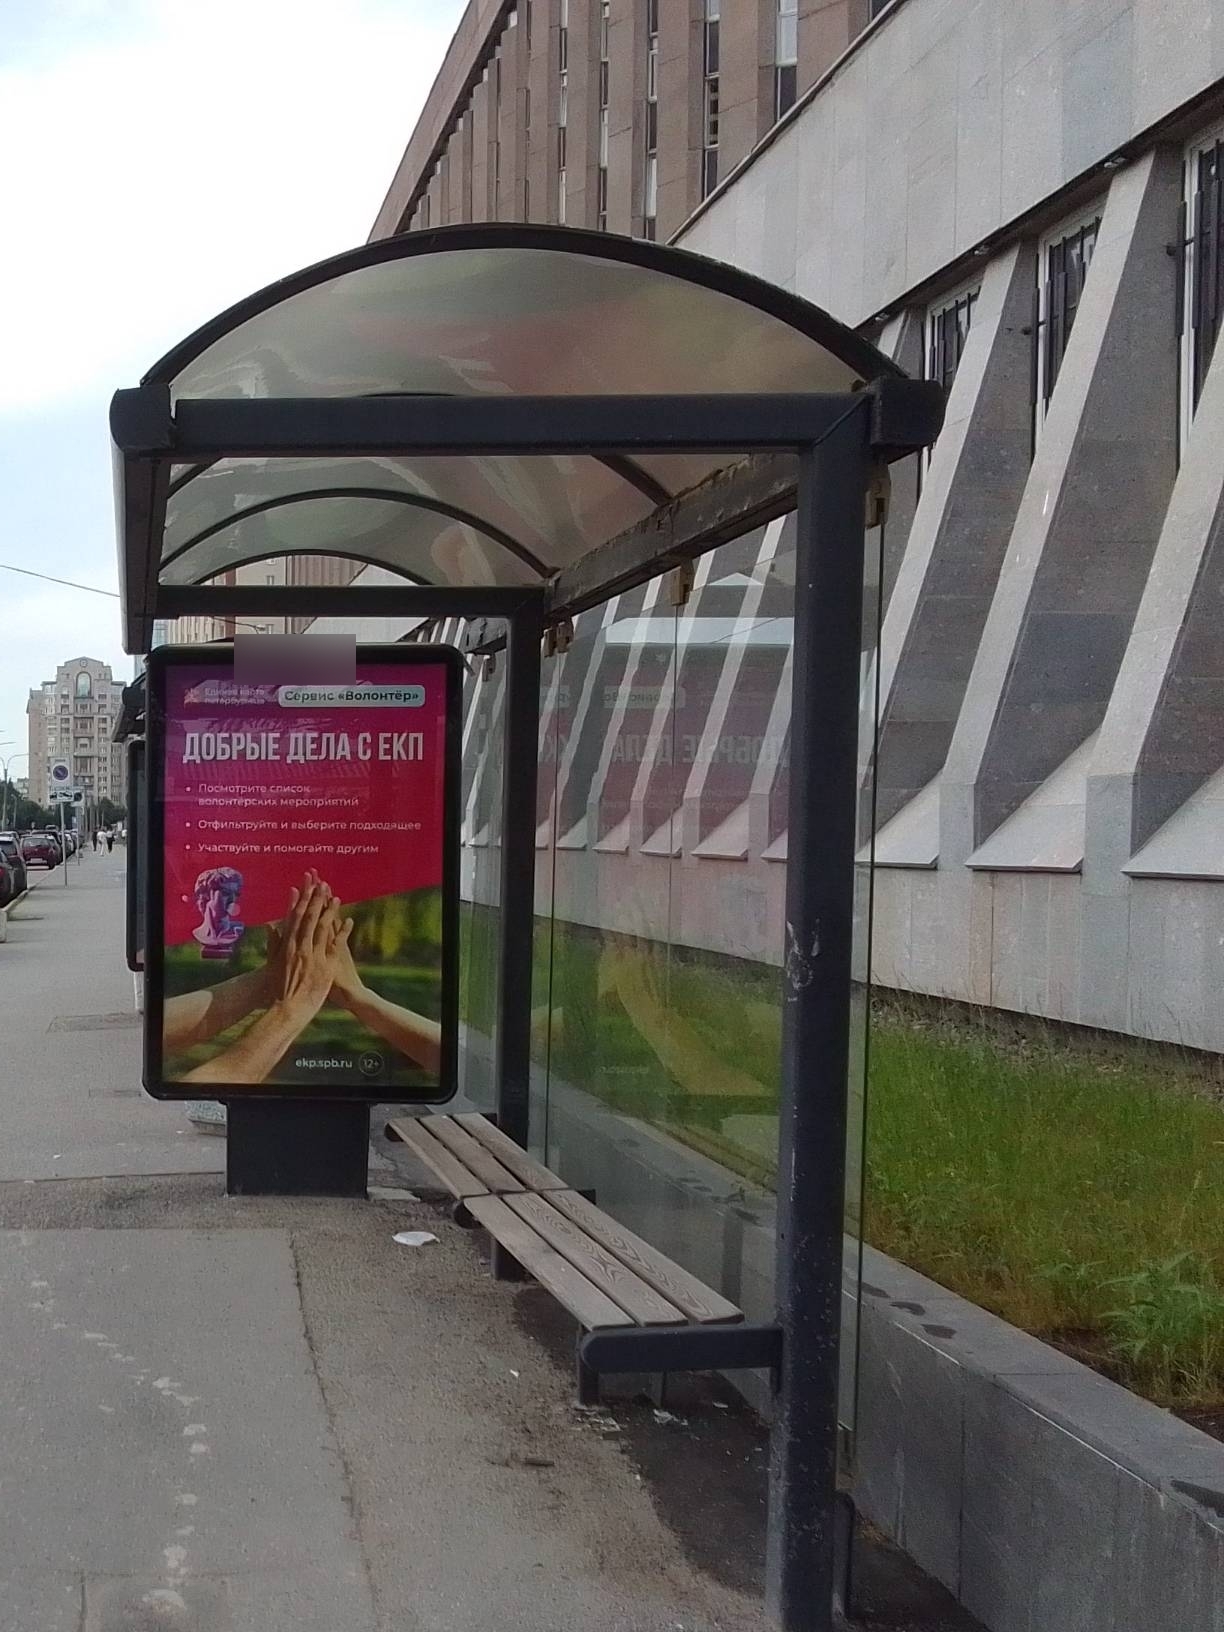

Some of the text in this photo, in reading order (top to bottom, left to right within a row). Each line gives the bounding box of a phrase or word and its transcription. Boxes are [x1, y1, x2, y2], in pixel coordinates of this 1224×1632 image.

[284, 689, 419, 704] Сервис «Волонтёр»
[183, 732, 424, 763] ДОБРЫЕ ДЕЛА С ЕКП
[198, 784, 311, 796] Посмотрите список
[280, 797, 359, 809] мероприятий
[198, 820, 422, 832] Отфильтруйте и выберите подходящее
[198, 843, 379, 854] Участвуйте и помогайте другим
[296, 1057, 353, 1070] ekp.spb.ru
[364, 1059, 380, 1069] 12+
